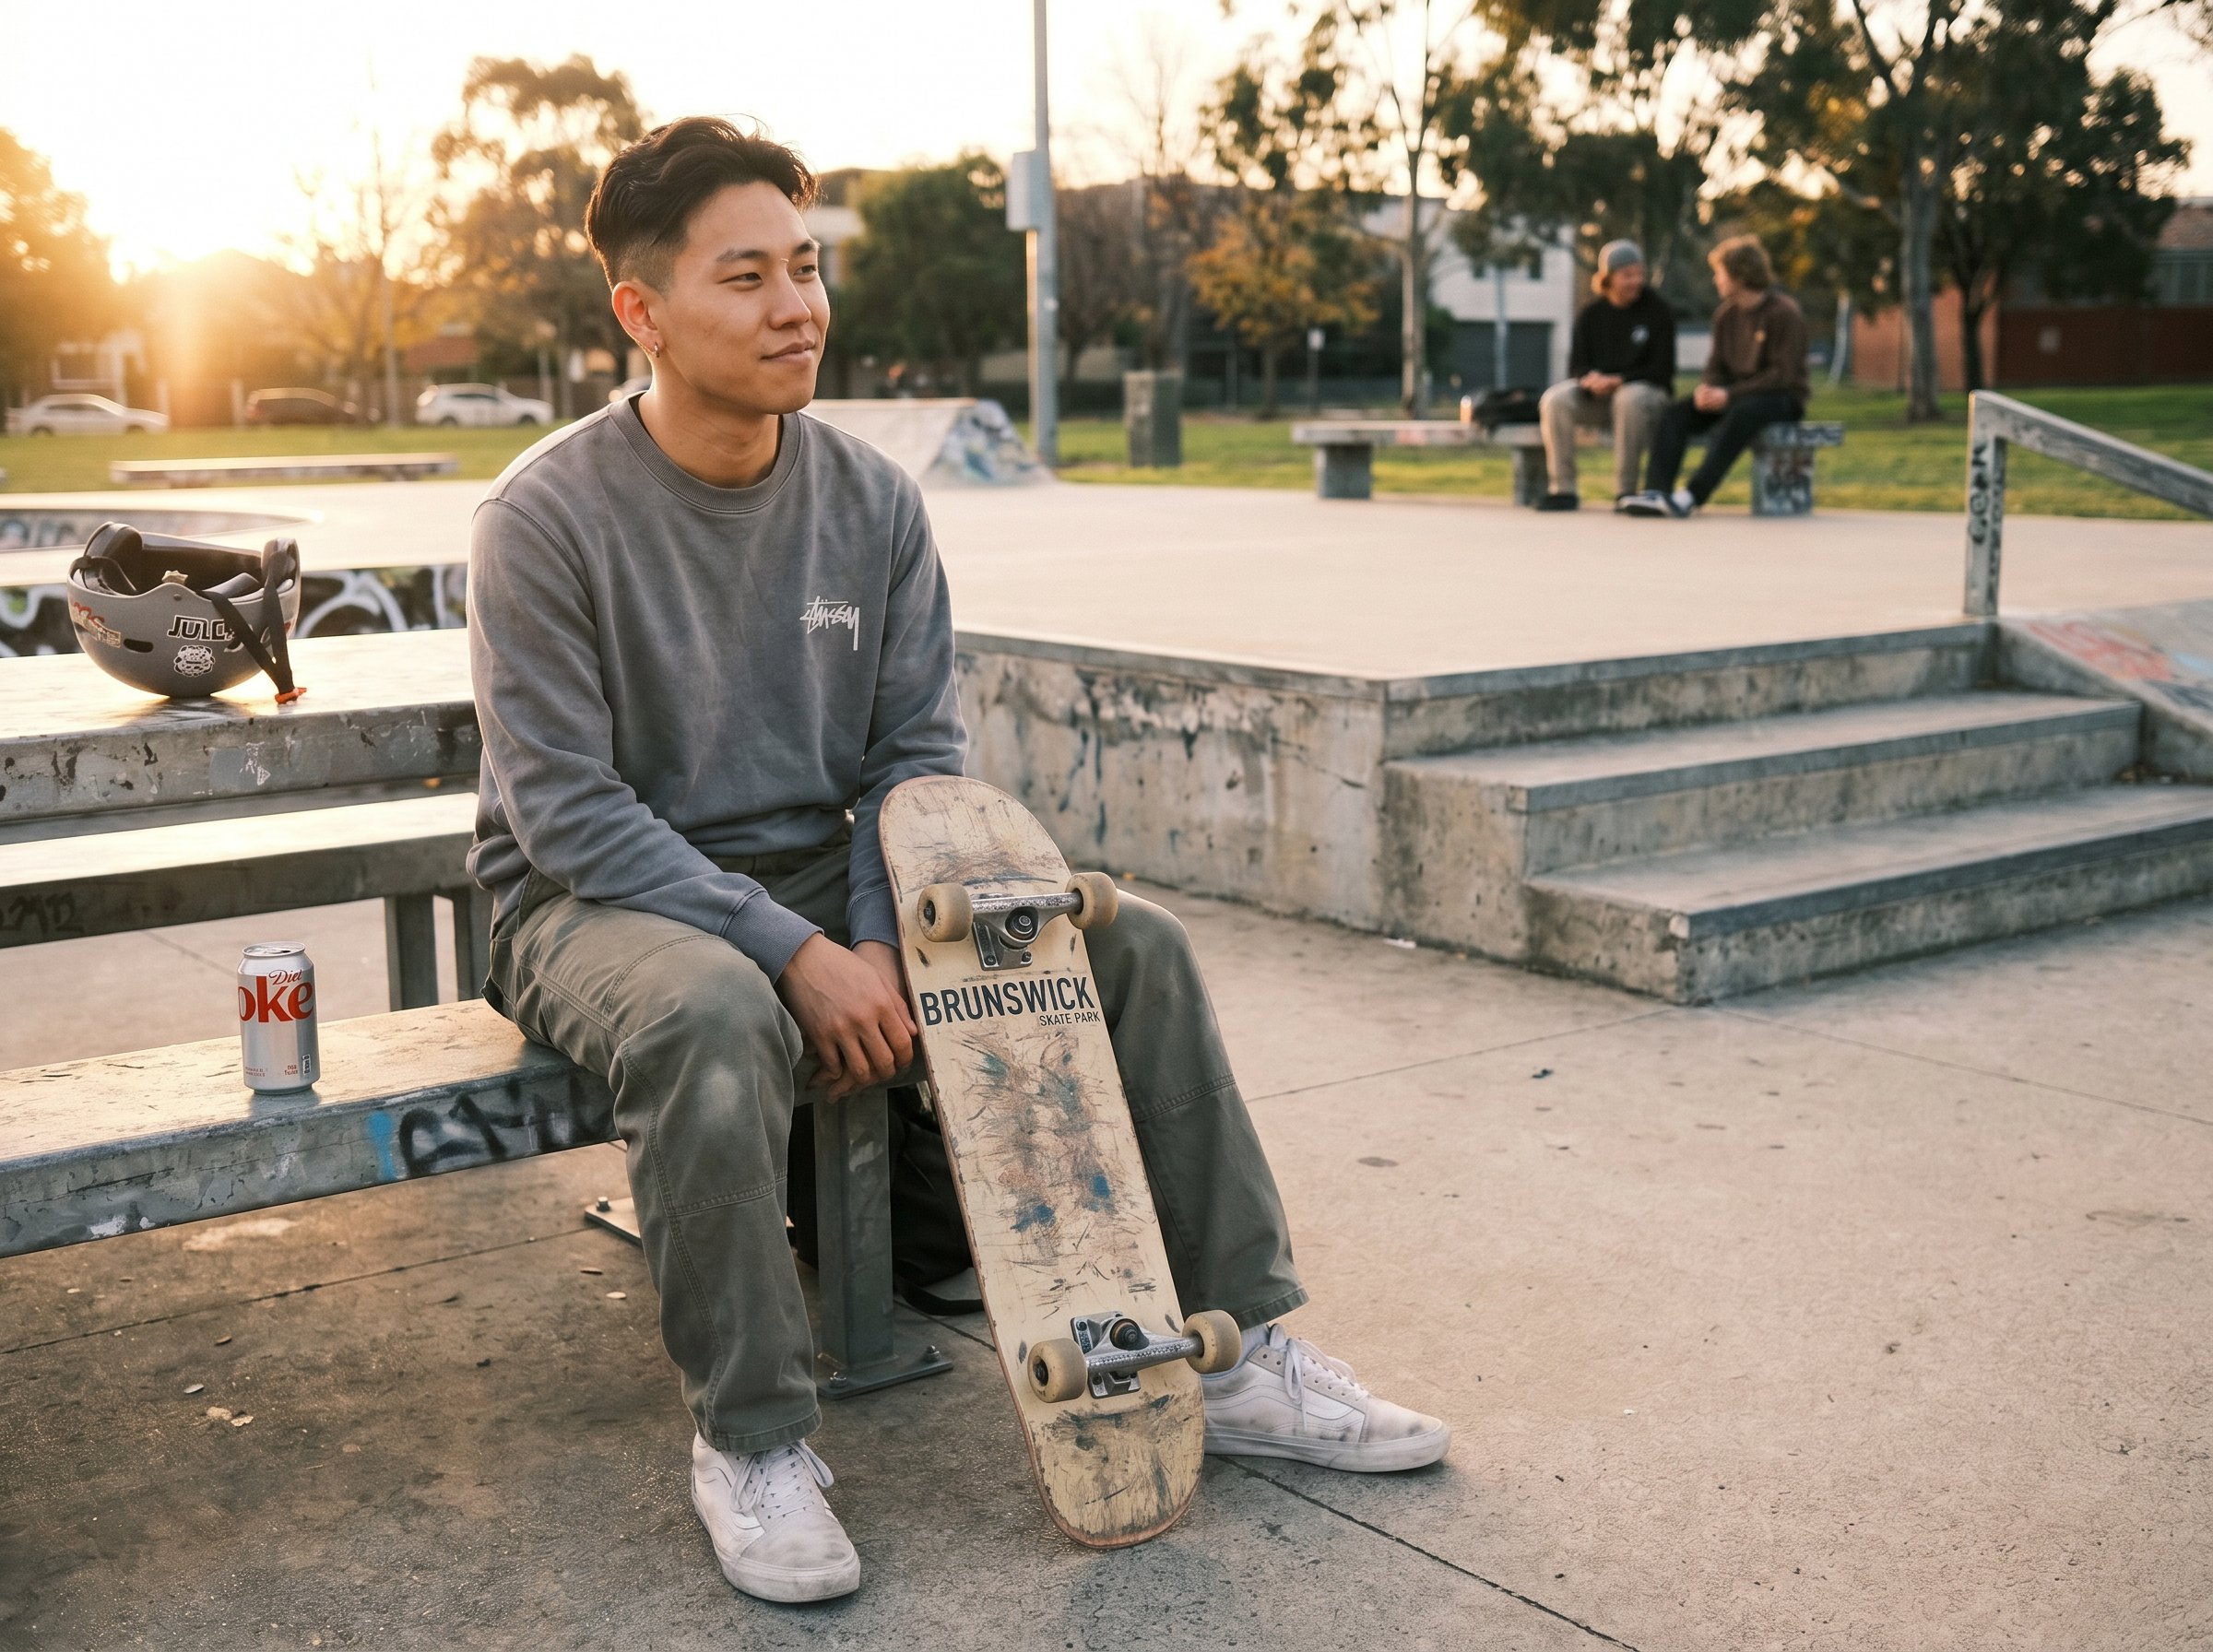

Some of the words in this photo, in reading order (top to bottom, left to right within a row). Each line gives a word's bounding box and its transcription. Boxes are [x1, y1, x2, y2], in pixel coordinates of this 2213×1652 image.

[268, 969, 302, 985] Diet
[238, 975, 314, 1023] oke
[919, 976, 1095, 1026] BRUNSWICK
[1040, 1013, 1072, 1026] SKATE
[1074, 1011, 1101, 1024] PARK
